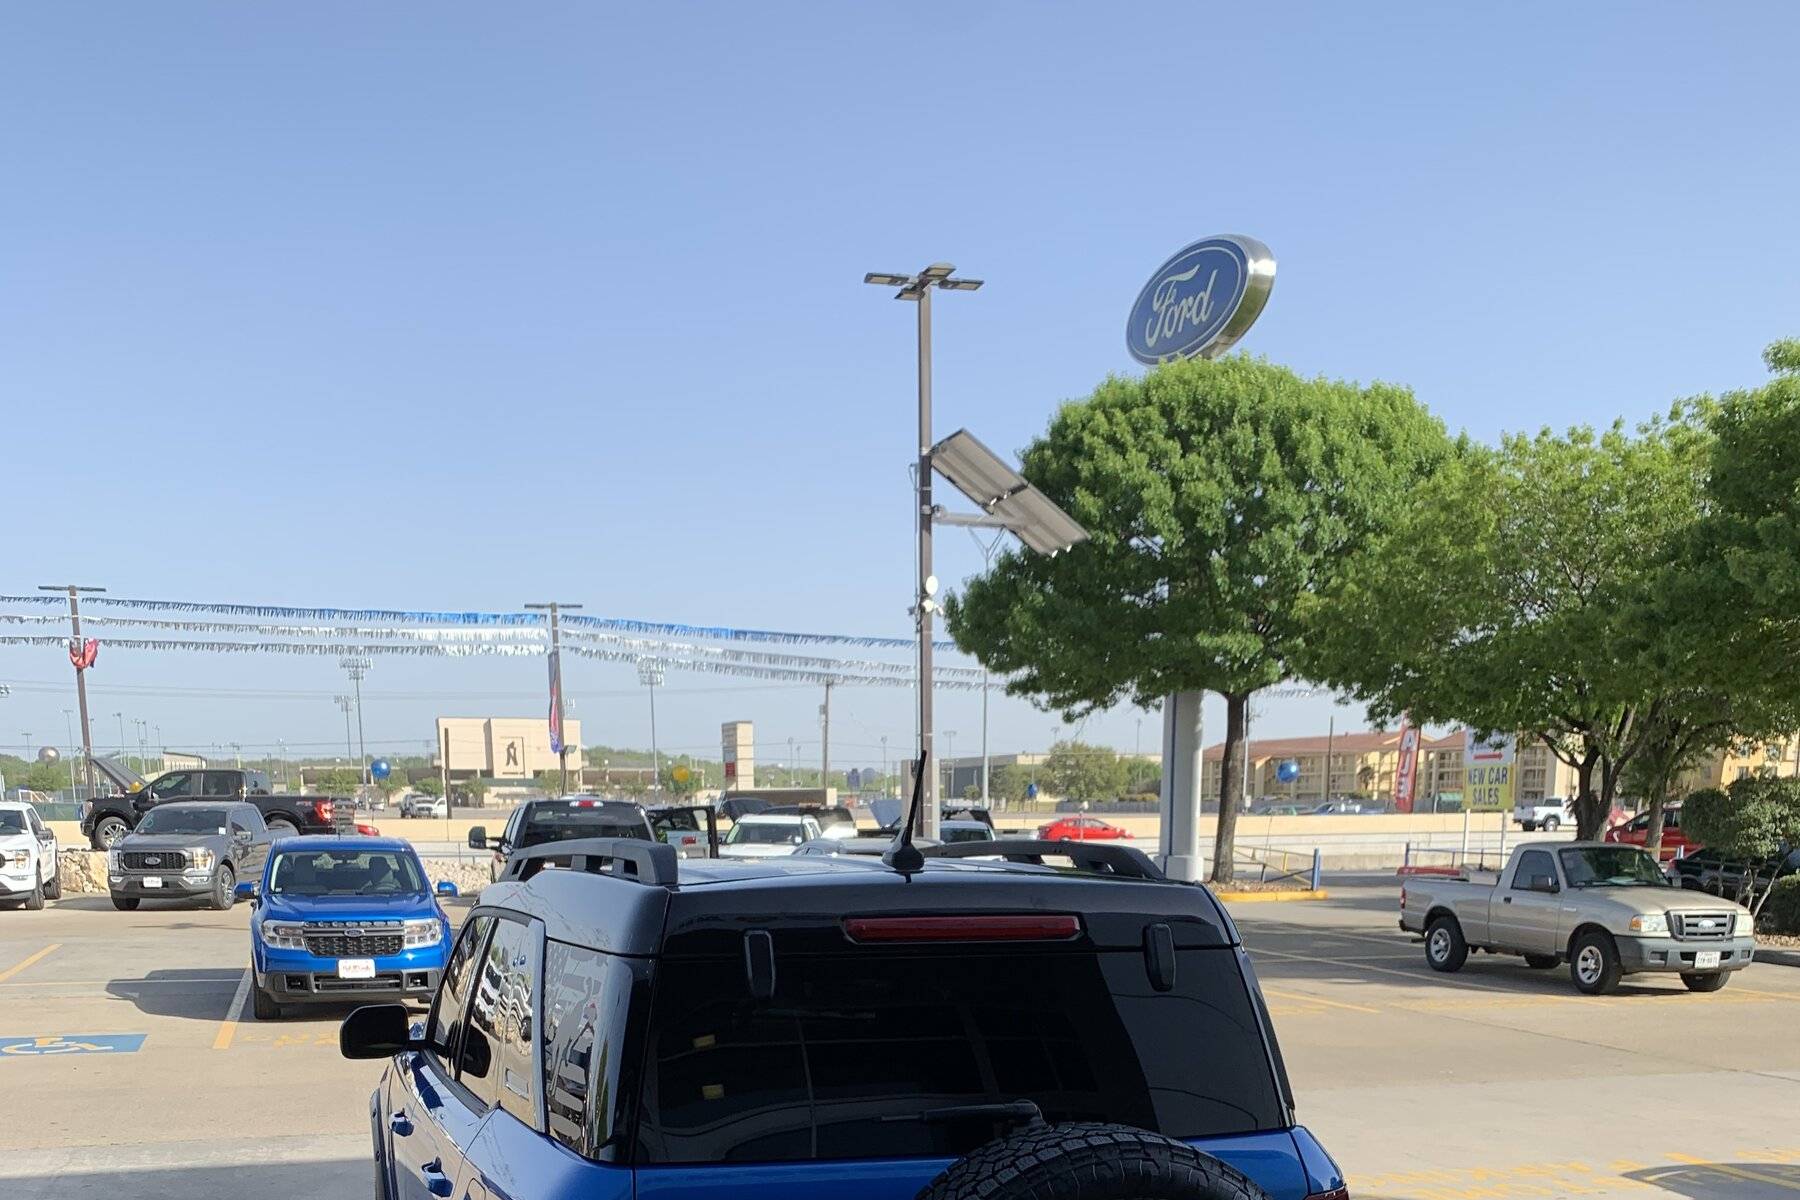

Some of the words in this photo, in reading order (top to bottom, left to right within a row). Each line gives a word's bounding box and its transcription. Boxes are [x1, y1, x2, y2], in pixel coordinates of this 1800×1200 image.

[1145, 263, 1218, 348] Ford
[1468, 768, 1485, 785] NEW
[1488, 766, 1508, 784] CAR
[1472, 787, 1499, 806] SALES
